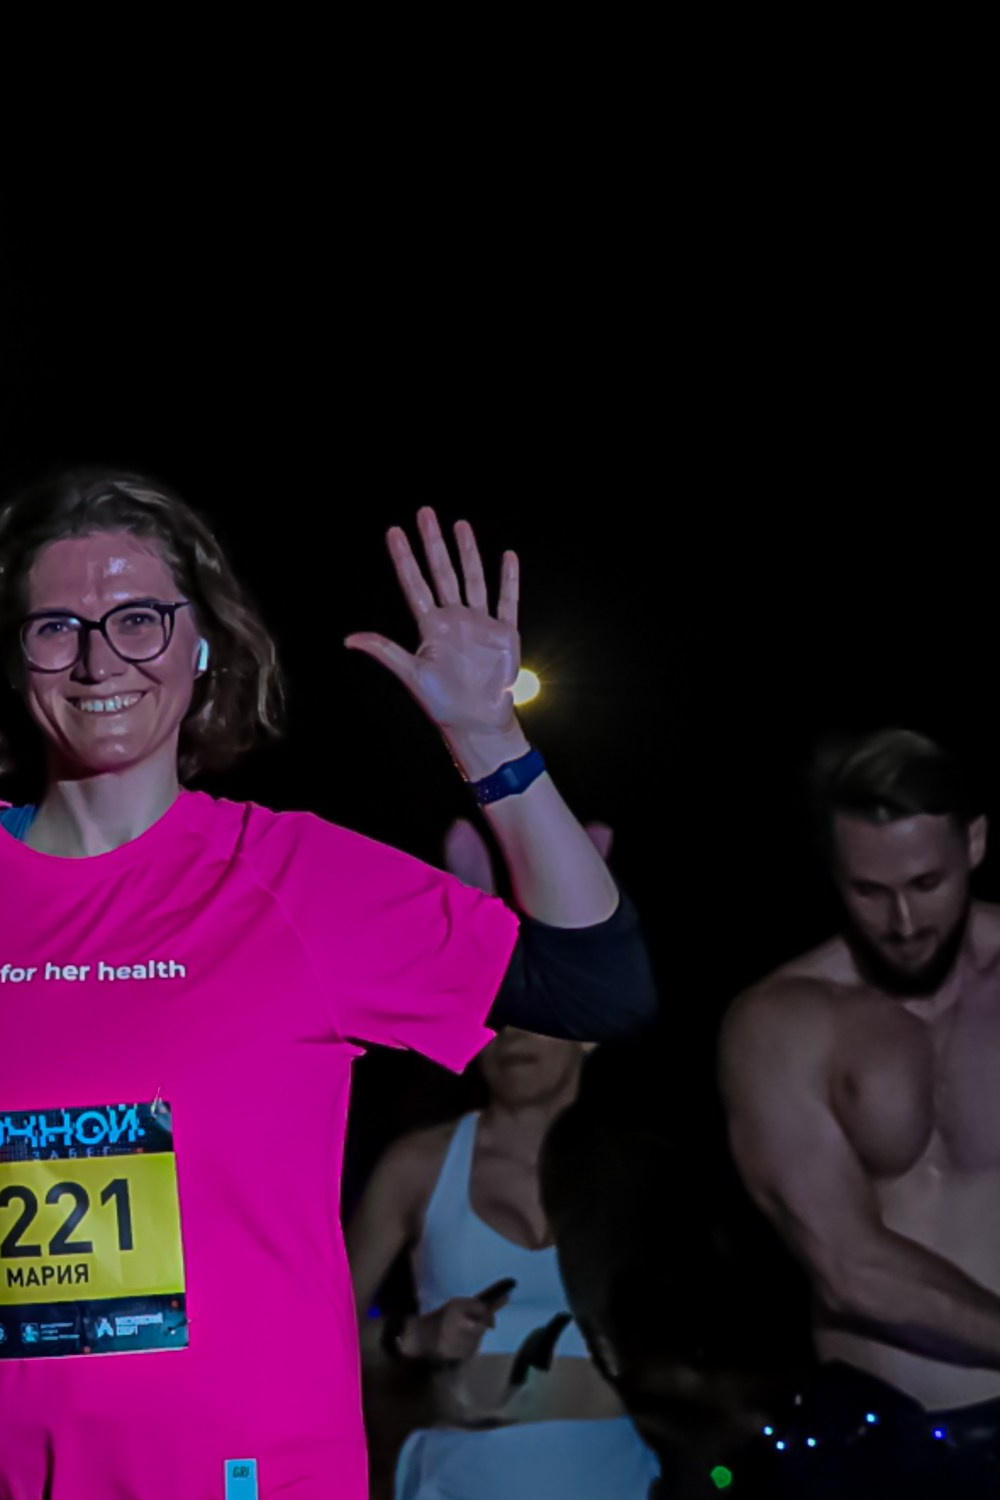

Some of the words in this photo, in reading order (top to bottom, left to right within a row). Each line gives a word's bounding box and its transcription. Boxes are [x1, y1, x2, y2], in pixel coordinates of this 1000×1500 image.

[0, 963, 38, 984] for
[44, 961, 91, 982] her
[98, 959, 187, 981] health
[7, 1264, 90, 1287] МАРИЯ
